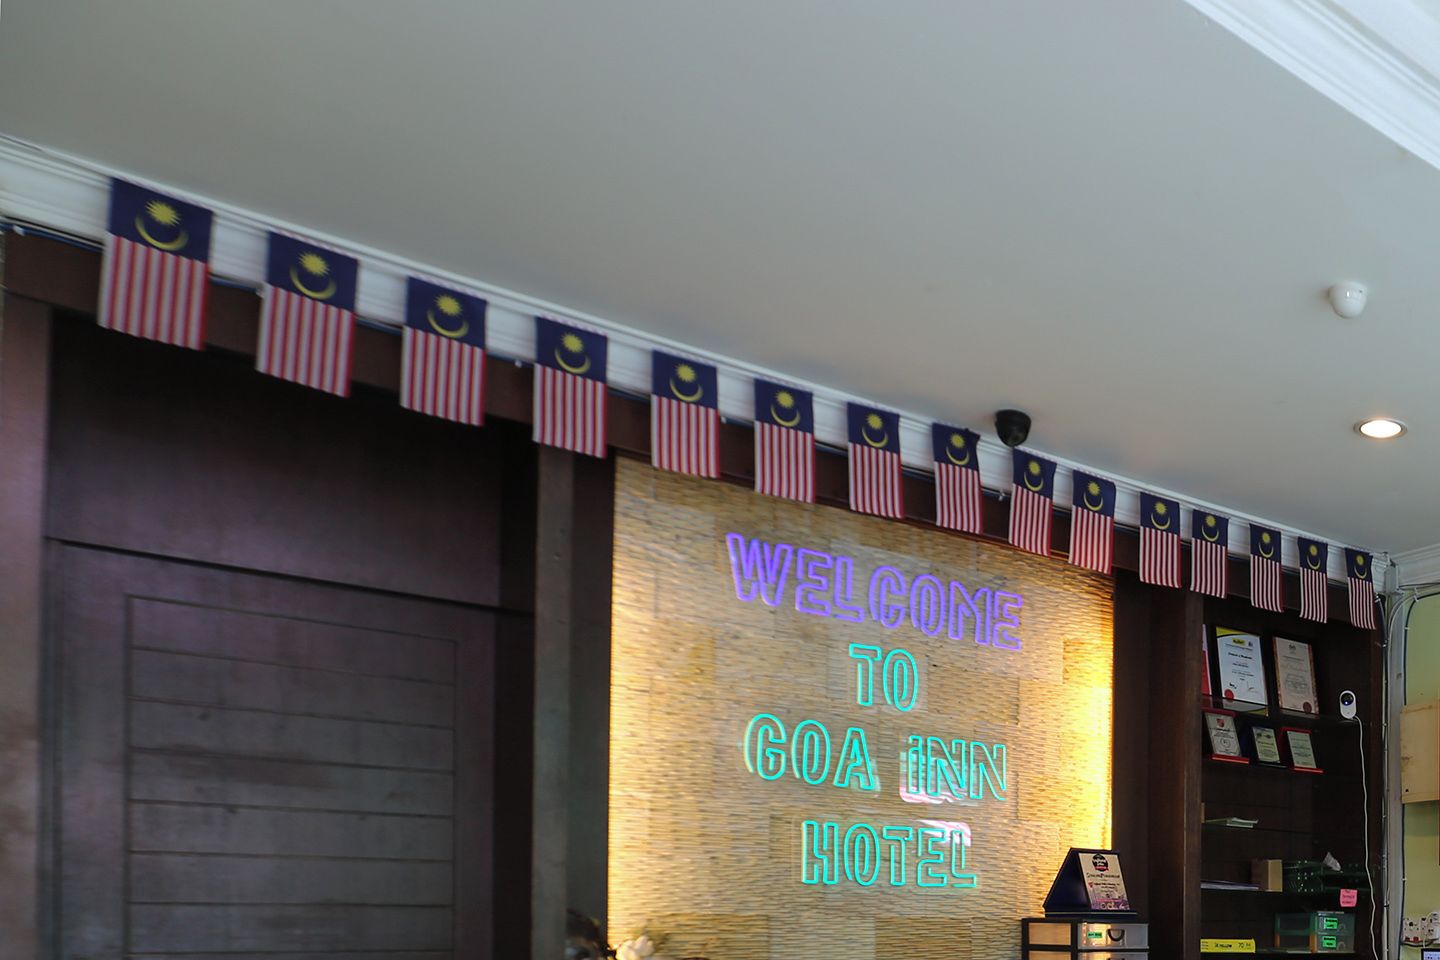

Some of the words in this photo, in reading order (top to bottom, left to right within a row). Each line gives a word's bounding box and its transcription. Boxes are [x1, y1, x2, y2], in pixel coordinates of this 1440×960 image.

[726, 533, 1023, 650] WELCOME
[849, 643, 919, 712] TO
[744, 714, 875, 791] GOA
[802, 820, 977, 888] HOTEL
